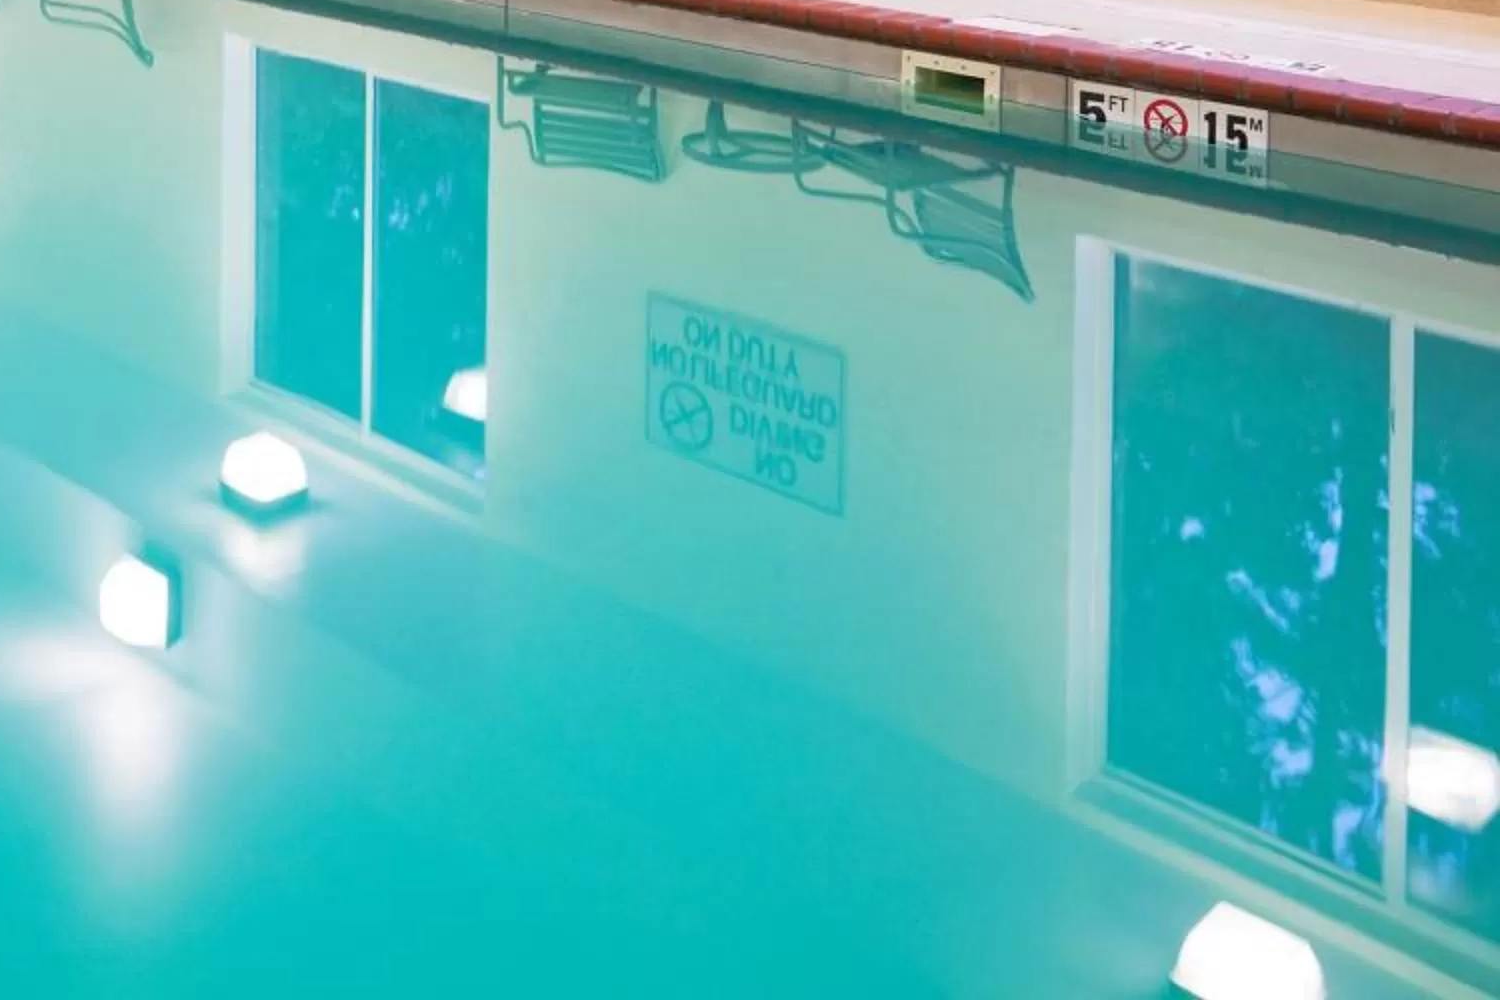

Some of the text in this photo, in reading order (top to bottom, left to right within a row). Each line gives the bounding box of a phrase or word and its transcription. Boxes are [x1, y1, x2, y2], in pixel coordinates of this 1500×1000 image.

[1079, 90, 1107, 123] 5
[1109, 95, 1129, 113] FT
[1250, 117, 1263, 133] M
